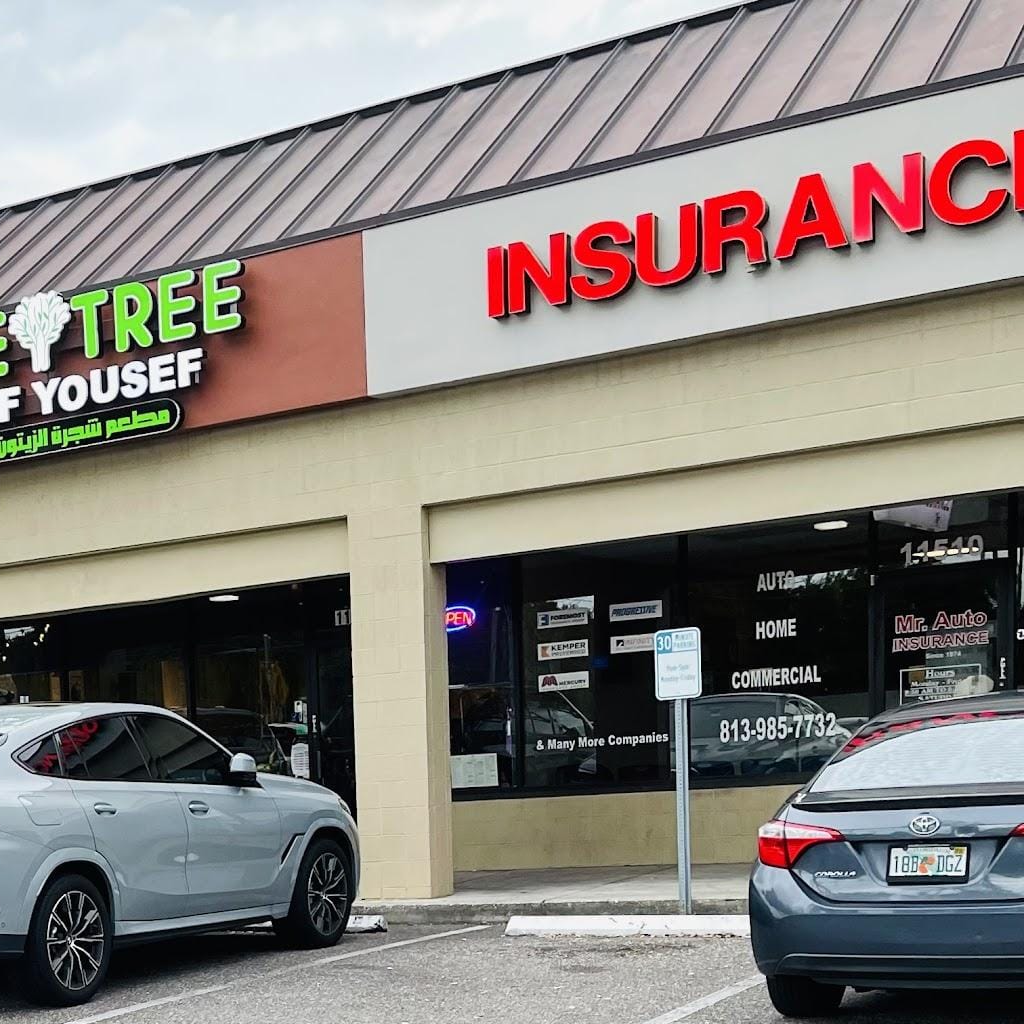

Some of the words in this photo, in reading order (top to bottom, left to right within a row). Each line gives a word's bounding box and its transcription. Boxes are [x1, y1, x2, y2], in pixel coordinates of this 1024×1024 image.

[487, 130, 1024, 319] INSURANC
[70, 259, 242, 359] TREE
[31, 348, 204, 416] YOUSEF
[51, 418, 103, 448] شجرة
[106, 409, 171, 439] مطعم
[756, 570, 795, 592] AUTO
[445, 611, 472, 627] PEN
[755, 618, 797, 640] HOME
[895, 614, 928, 635] Mr.
[932, 609, 988, 631] Auto
[551, 642, 586, 652] KEMPER
[657, 635, 672, 650] 30
[892, 630, 990, 653] INSURANCE
[731, 665, 822, 689] COMMERCIAL
[719, 712, 837, 743] 813-985-7732
[536, 739, 544, 751] &
[547, 738, 576, 751] Many
[577, 737, 605, 748] More
[607, 731, 669, 747] Companies
[814, 870, 857, 878] COROLLA
